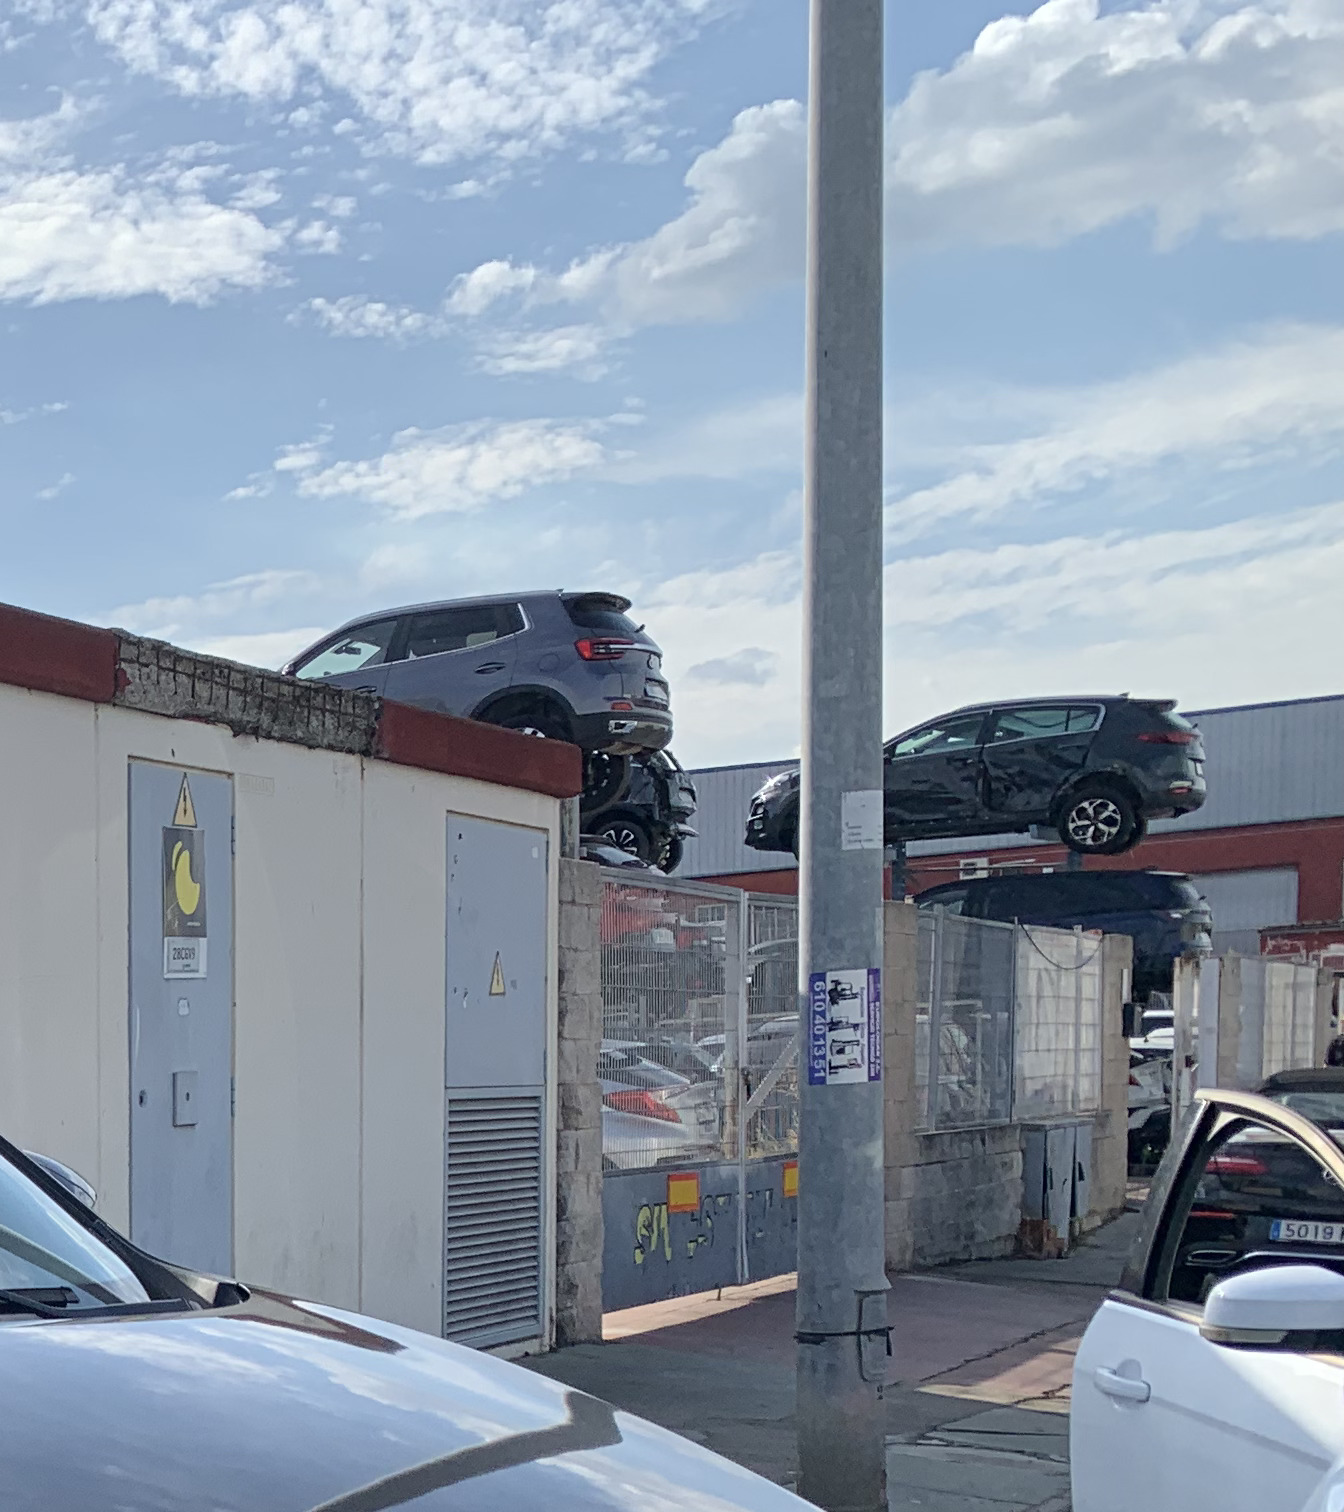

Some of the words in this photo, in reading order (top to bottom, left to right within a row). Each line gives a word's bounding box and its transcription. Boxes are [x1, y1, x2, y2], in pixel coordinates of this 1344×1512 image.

[814, 981, 826, 1012] 610
[814, 1014, 826, 1035] 40
[814, 1040, 826, 1057] 13
[814, 1060, 826, 1078] 51
[1285, 1223, 1334, 1240] 5019
